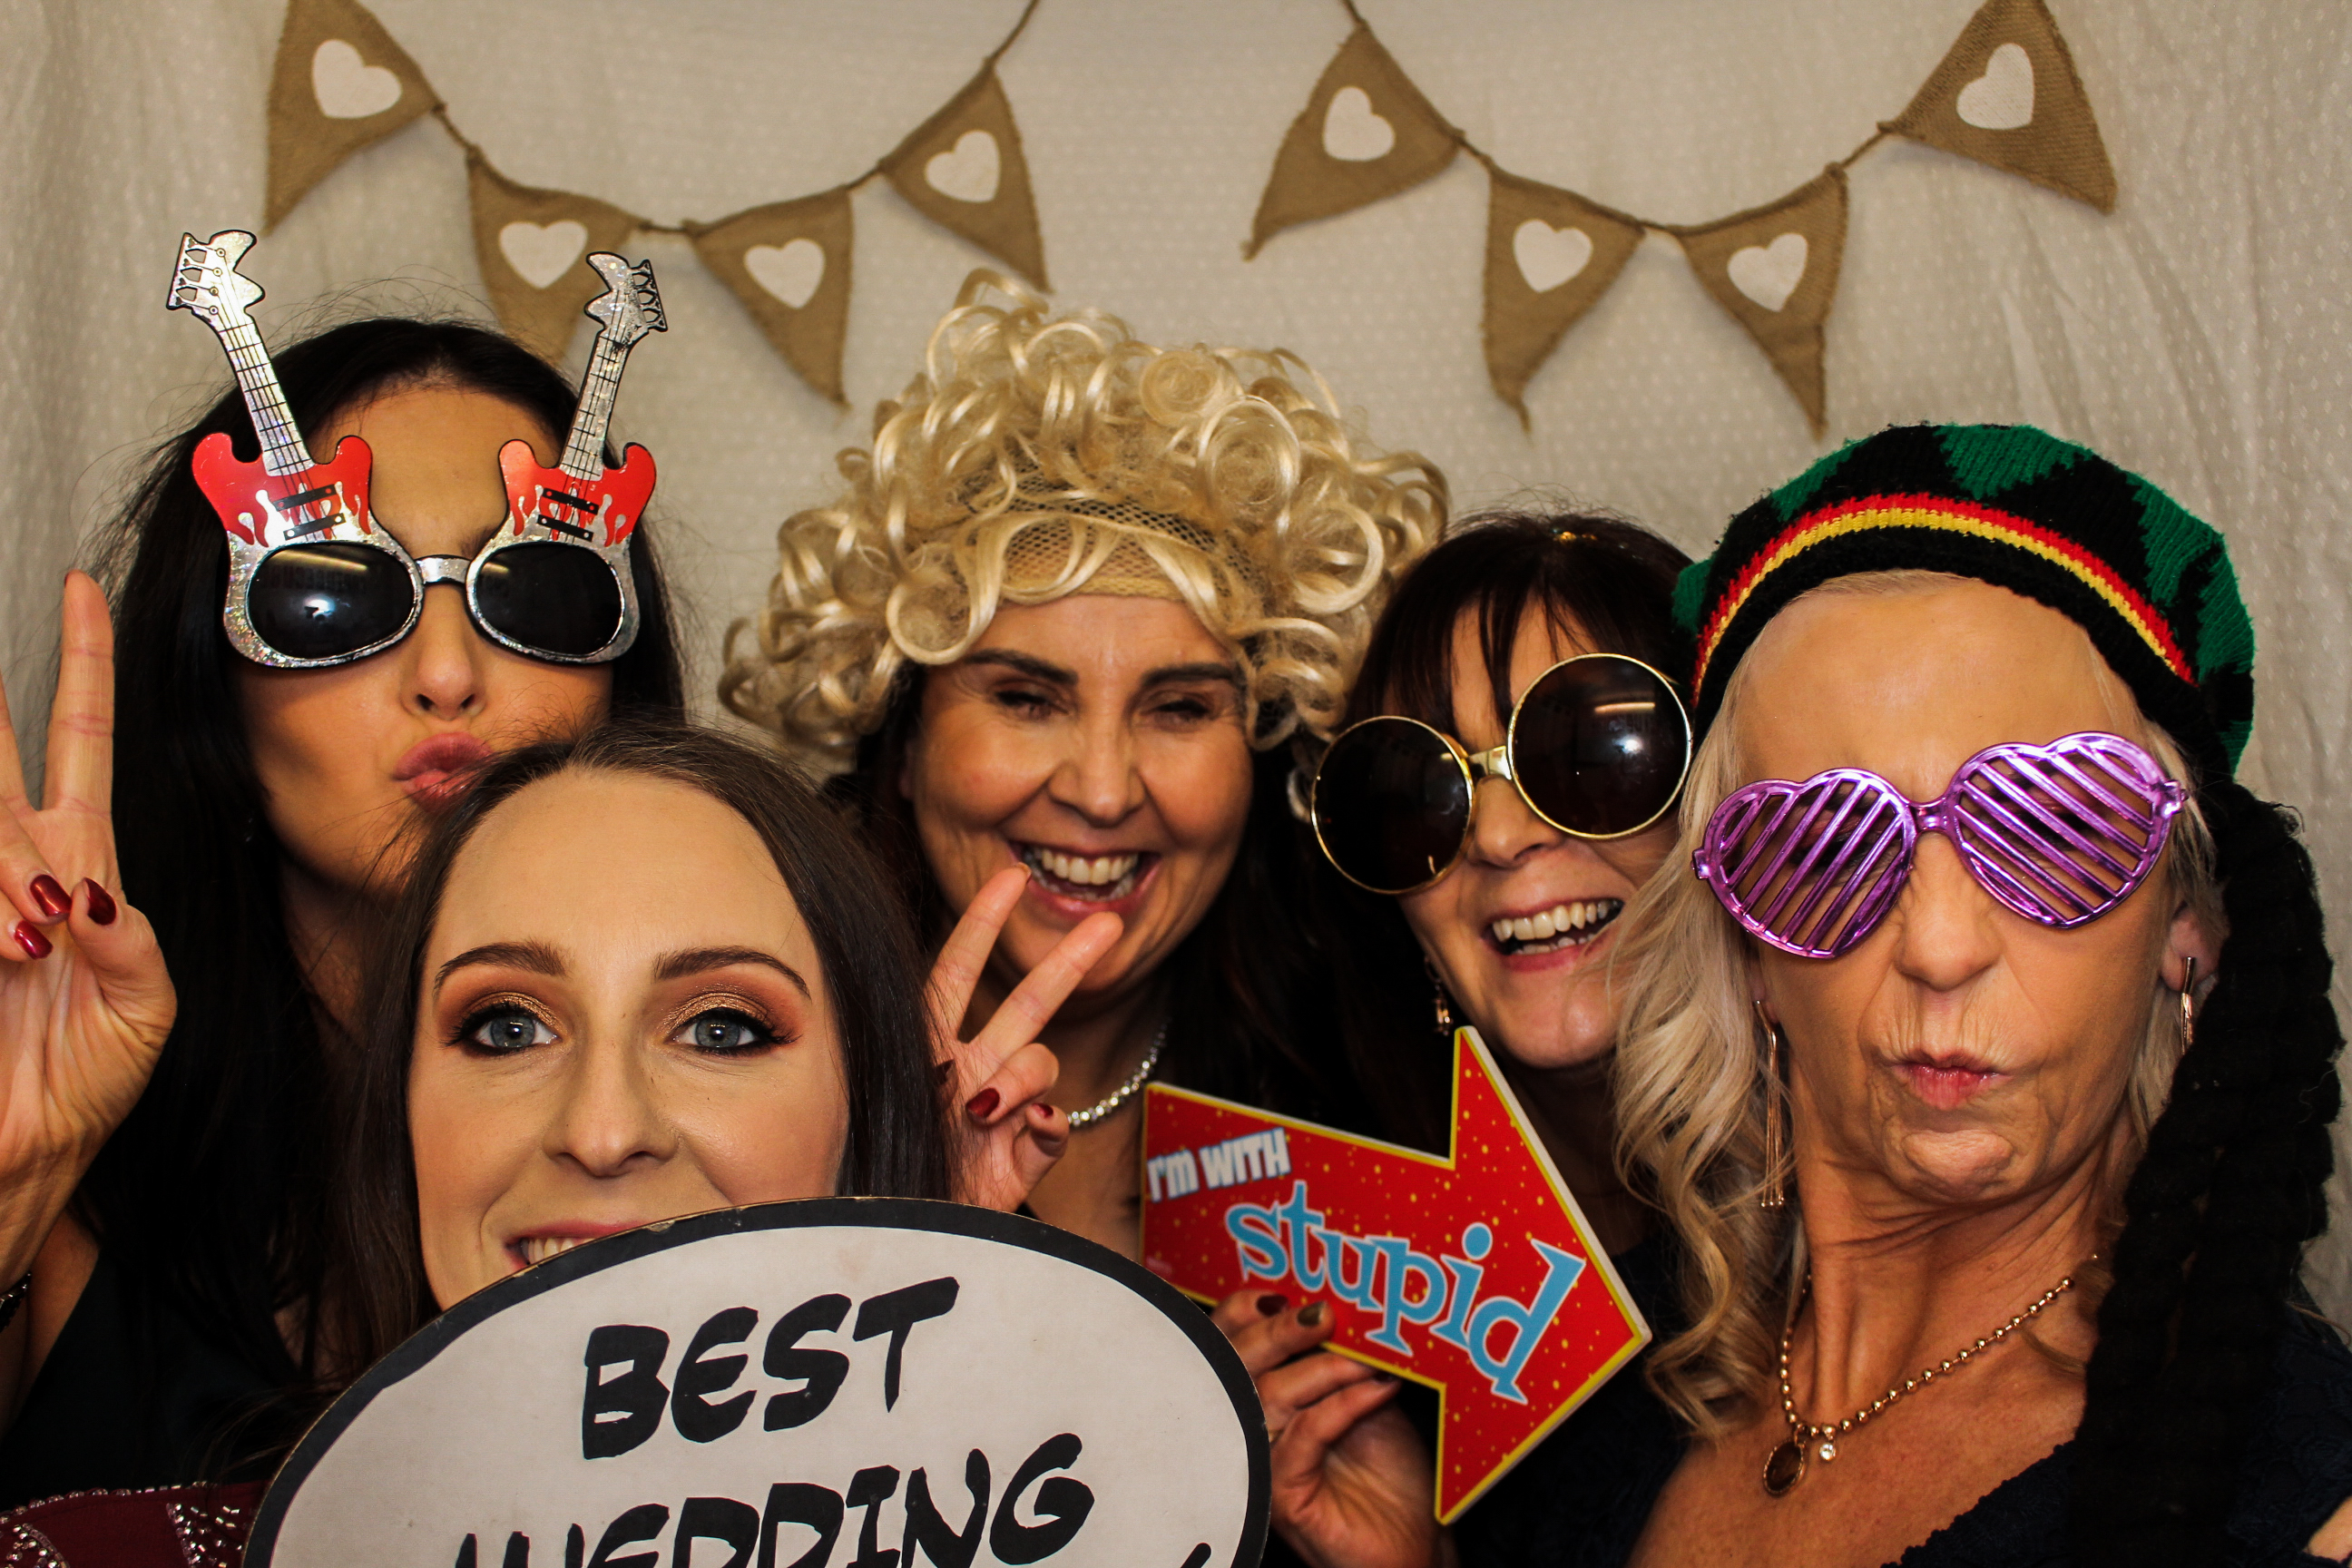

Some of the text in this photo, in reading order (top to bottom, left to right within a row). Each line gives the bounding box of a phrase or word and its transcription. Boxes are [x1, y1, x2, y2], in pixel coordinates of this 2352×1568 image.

[1198, 1126, 1292, 1191] WITH
[582, 1276, 960, 1461] BEST
[1224, 1180, 1587, 1406] stupid
[455, 1433, 1095, 1568] DDING
